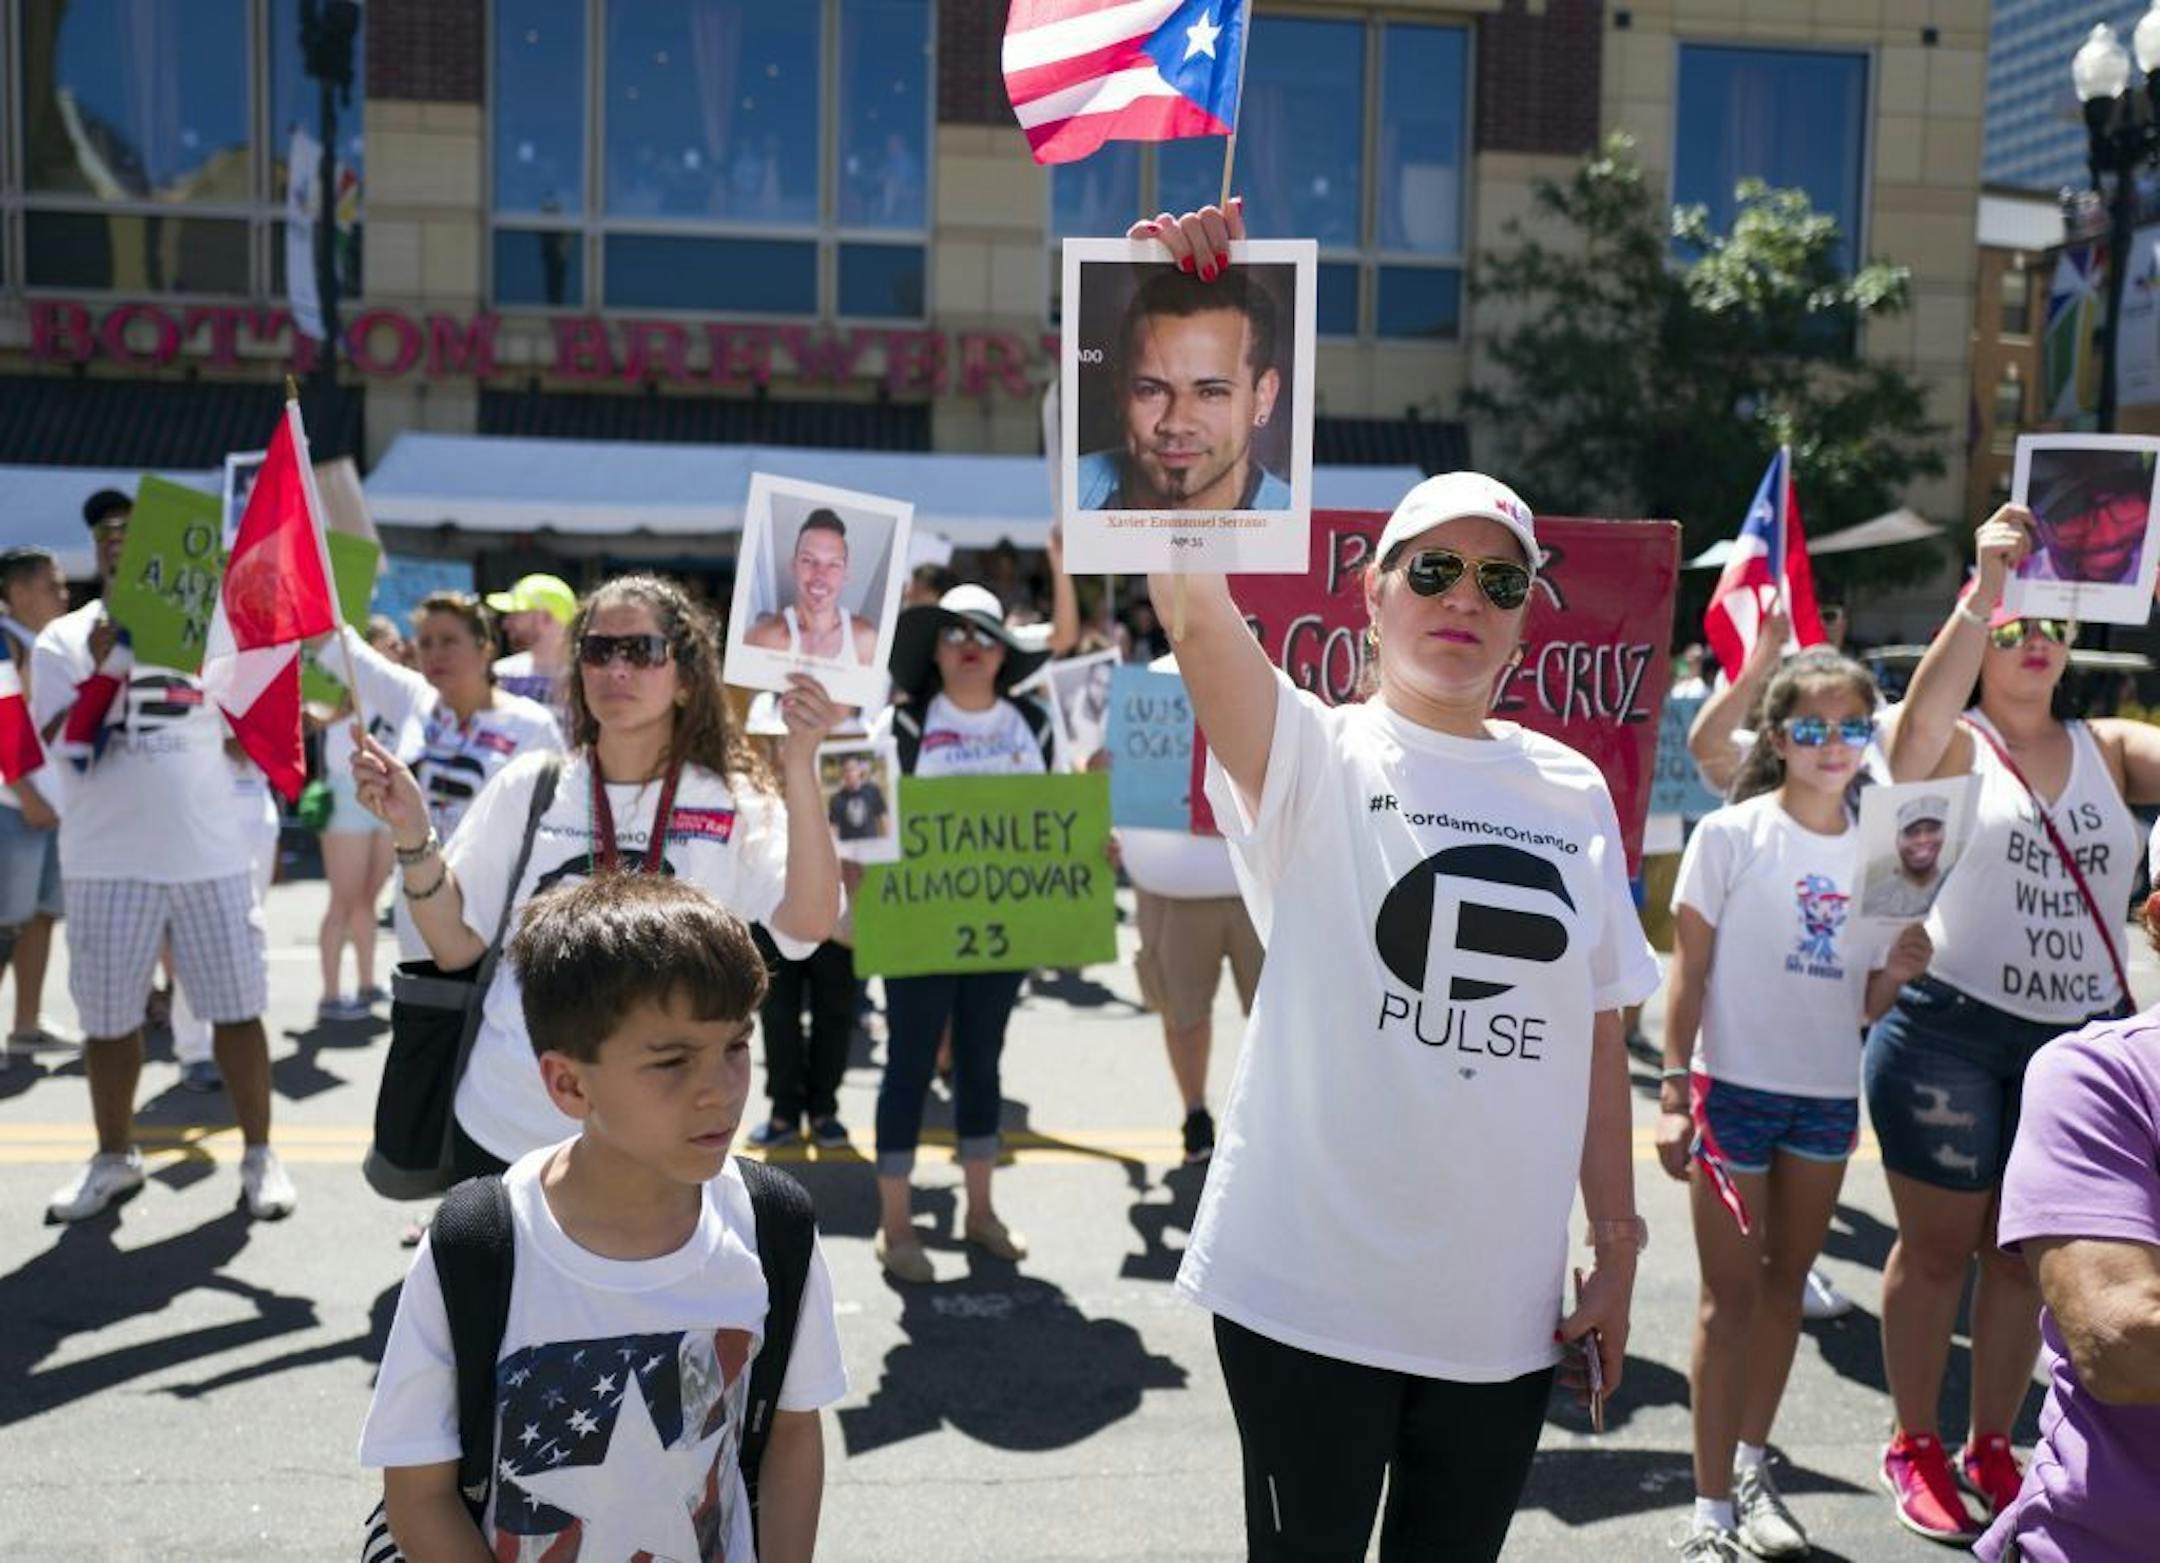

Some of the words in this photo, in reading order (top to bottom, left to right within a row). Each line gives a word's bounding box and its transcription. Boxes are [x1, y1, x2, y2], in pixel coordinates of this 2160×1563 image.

[554, 317, 1062, 397] BREWER
[1107, 516, 1146, 528] Xavier
[1150, 516, 1215, 529] Emmanuel
[1218, 516, 1267, 529] Serrano
[902, 811, 1077, 857] STANLEY
[2068, 802, 2102, 834] IS
[2007, 831, 2110, 878] BETTER
[881, 863, 1092, 904] ALMODOVAR
[956, 924, 1009, 957] 23
[2026, 928, 2083, 961] YOU
[2003, 964, 2104, 1001] DANCE
[1378, 991, 1547, 1061] PULSE
